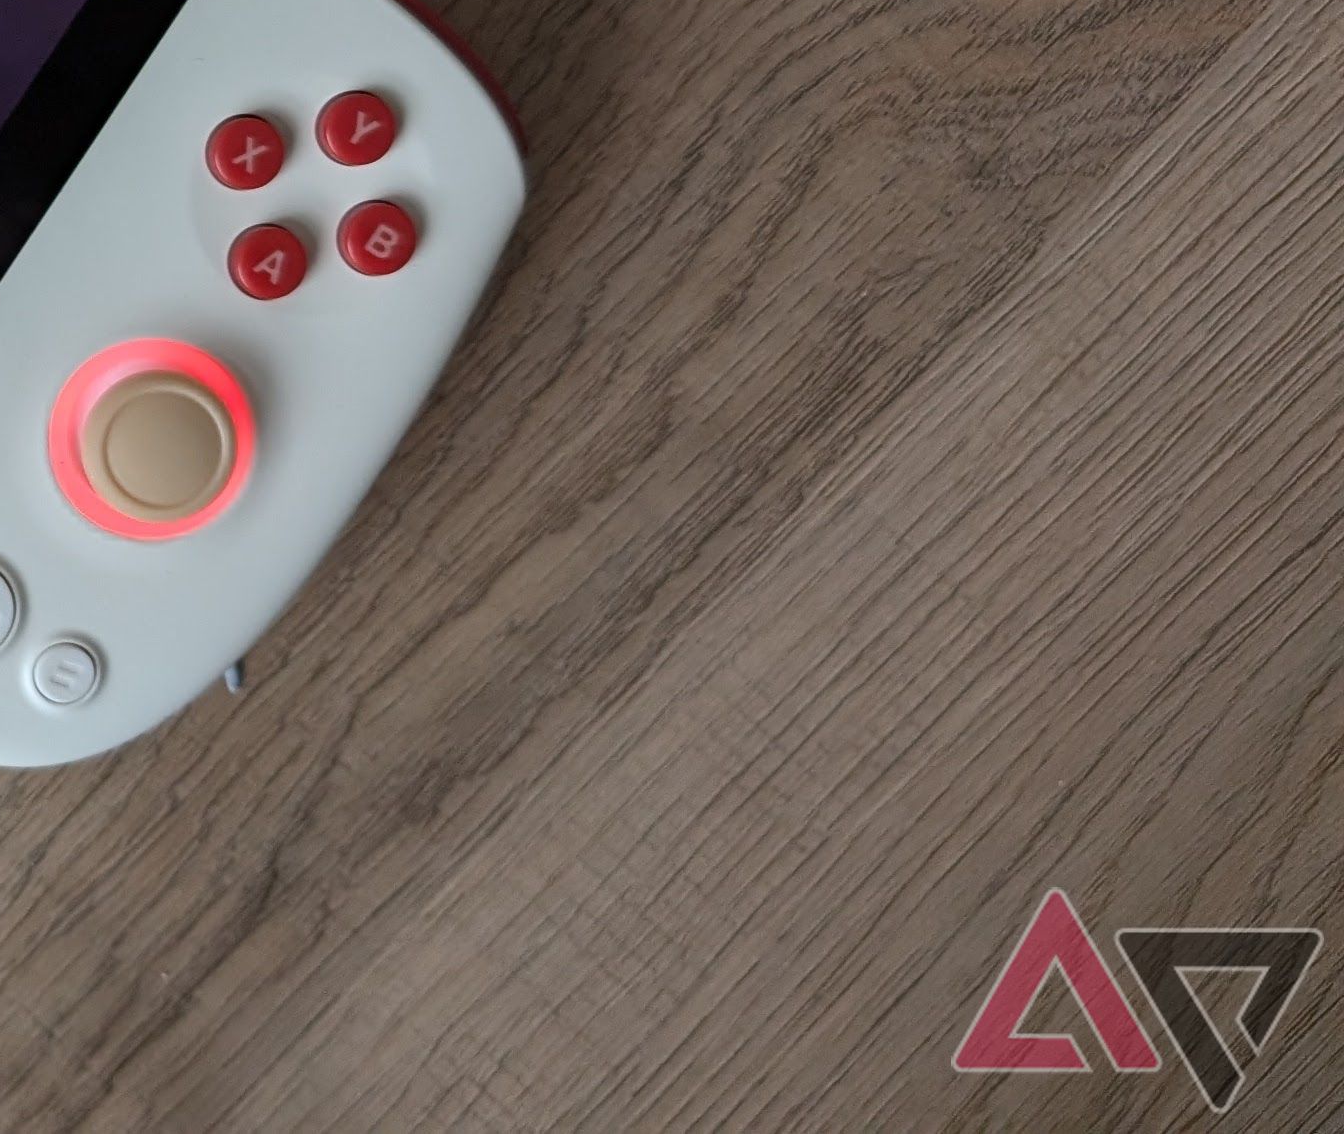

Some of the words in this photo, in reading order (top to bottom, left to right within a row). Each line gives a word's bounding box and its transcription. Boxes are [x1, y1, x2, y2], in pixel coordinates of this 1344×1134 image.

[349, 110, 382, 145] Y
[231, 135, 270, 174] X
[363, 223, 400, 259] B
[252, 249, 286, 286] A
